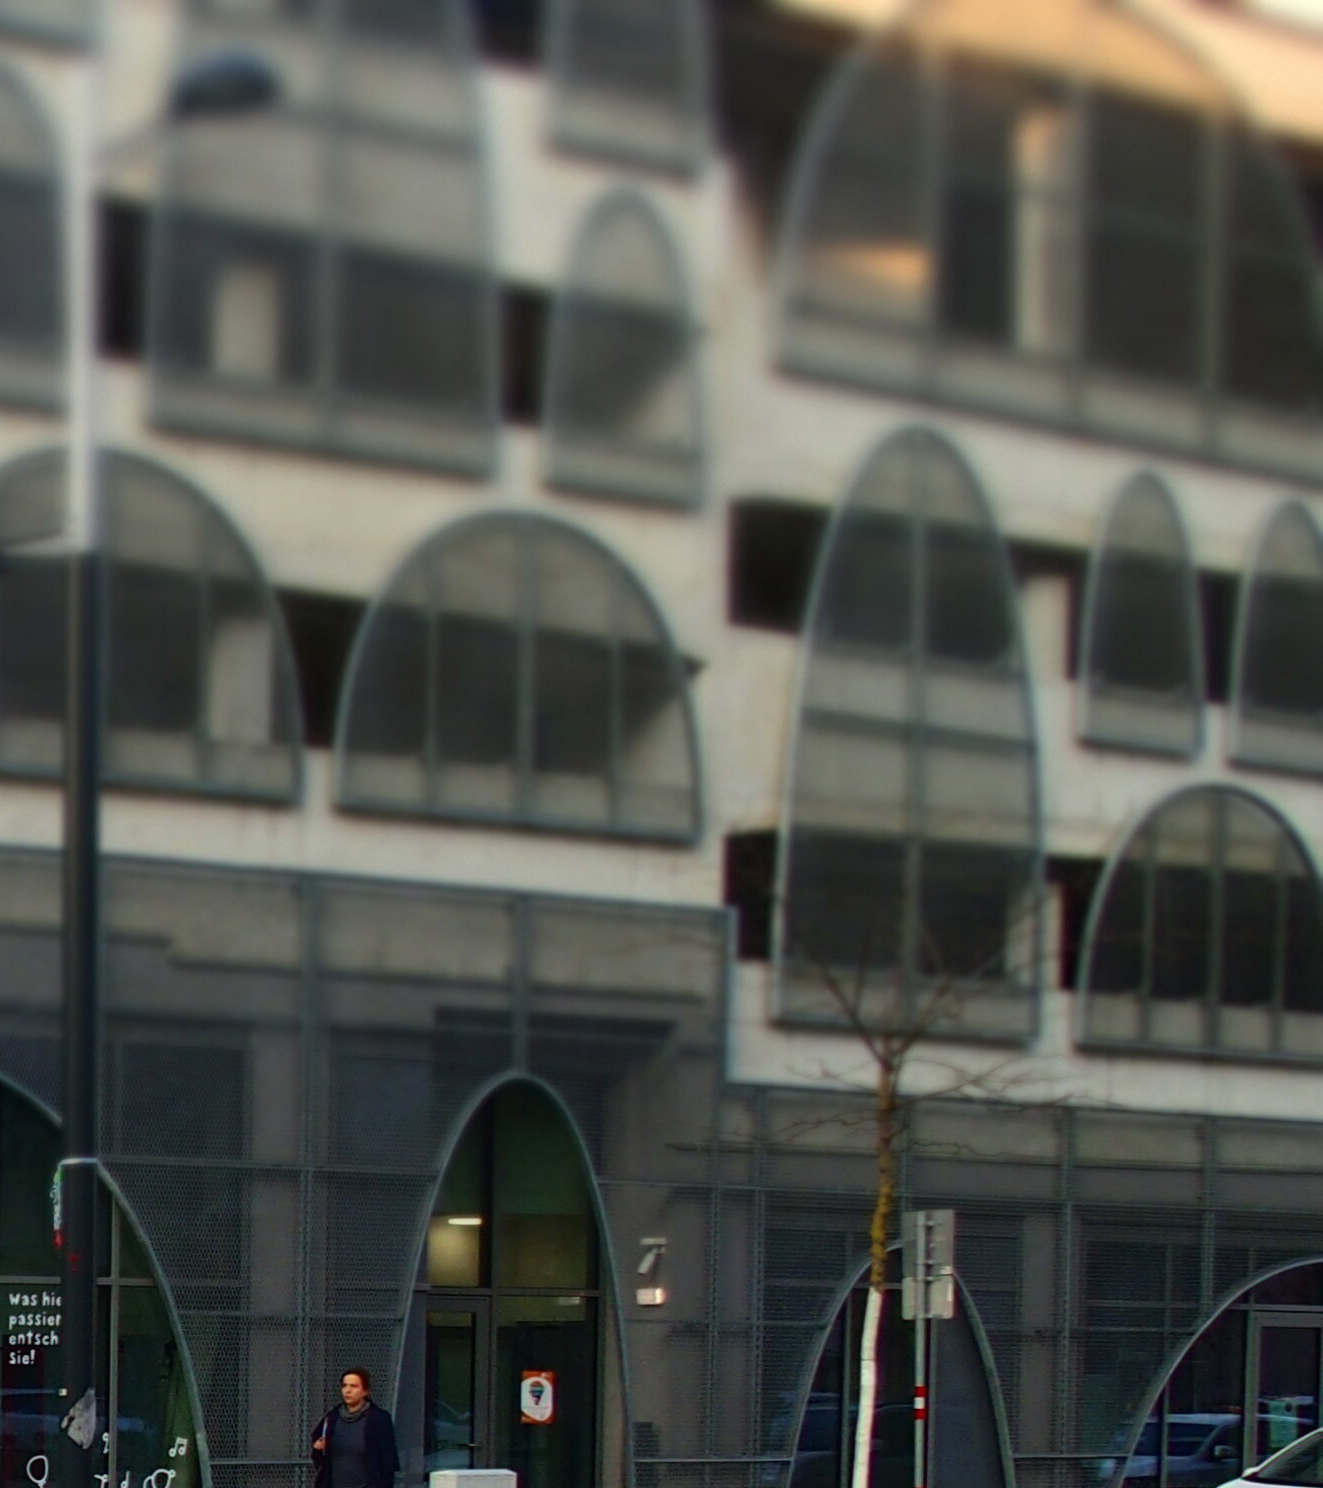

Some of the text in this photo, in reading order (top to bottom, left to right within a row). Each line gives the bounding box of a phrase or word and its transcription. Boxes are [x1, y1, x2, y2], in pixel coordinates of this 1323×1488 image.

[8, 1291, 62, 1307] Was hie
[8, 1314, 61, 1330] passier
[8, 1330, 59, 1346] entsch
[8, 1349, 36, 1365] Sie!
